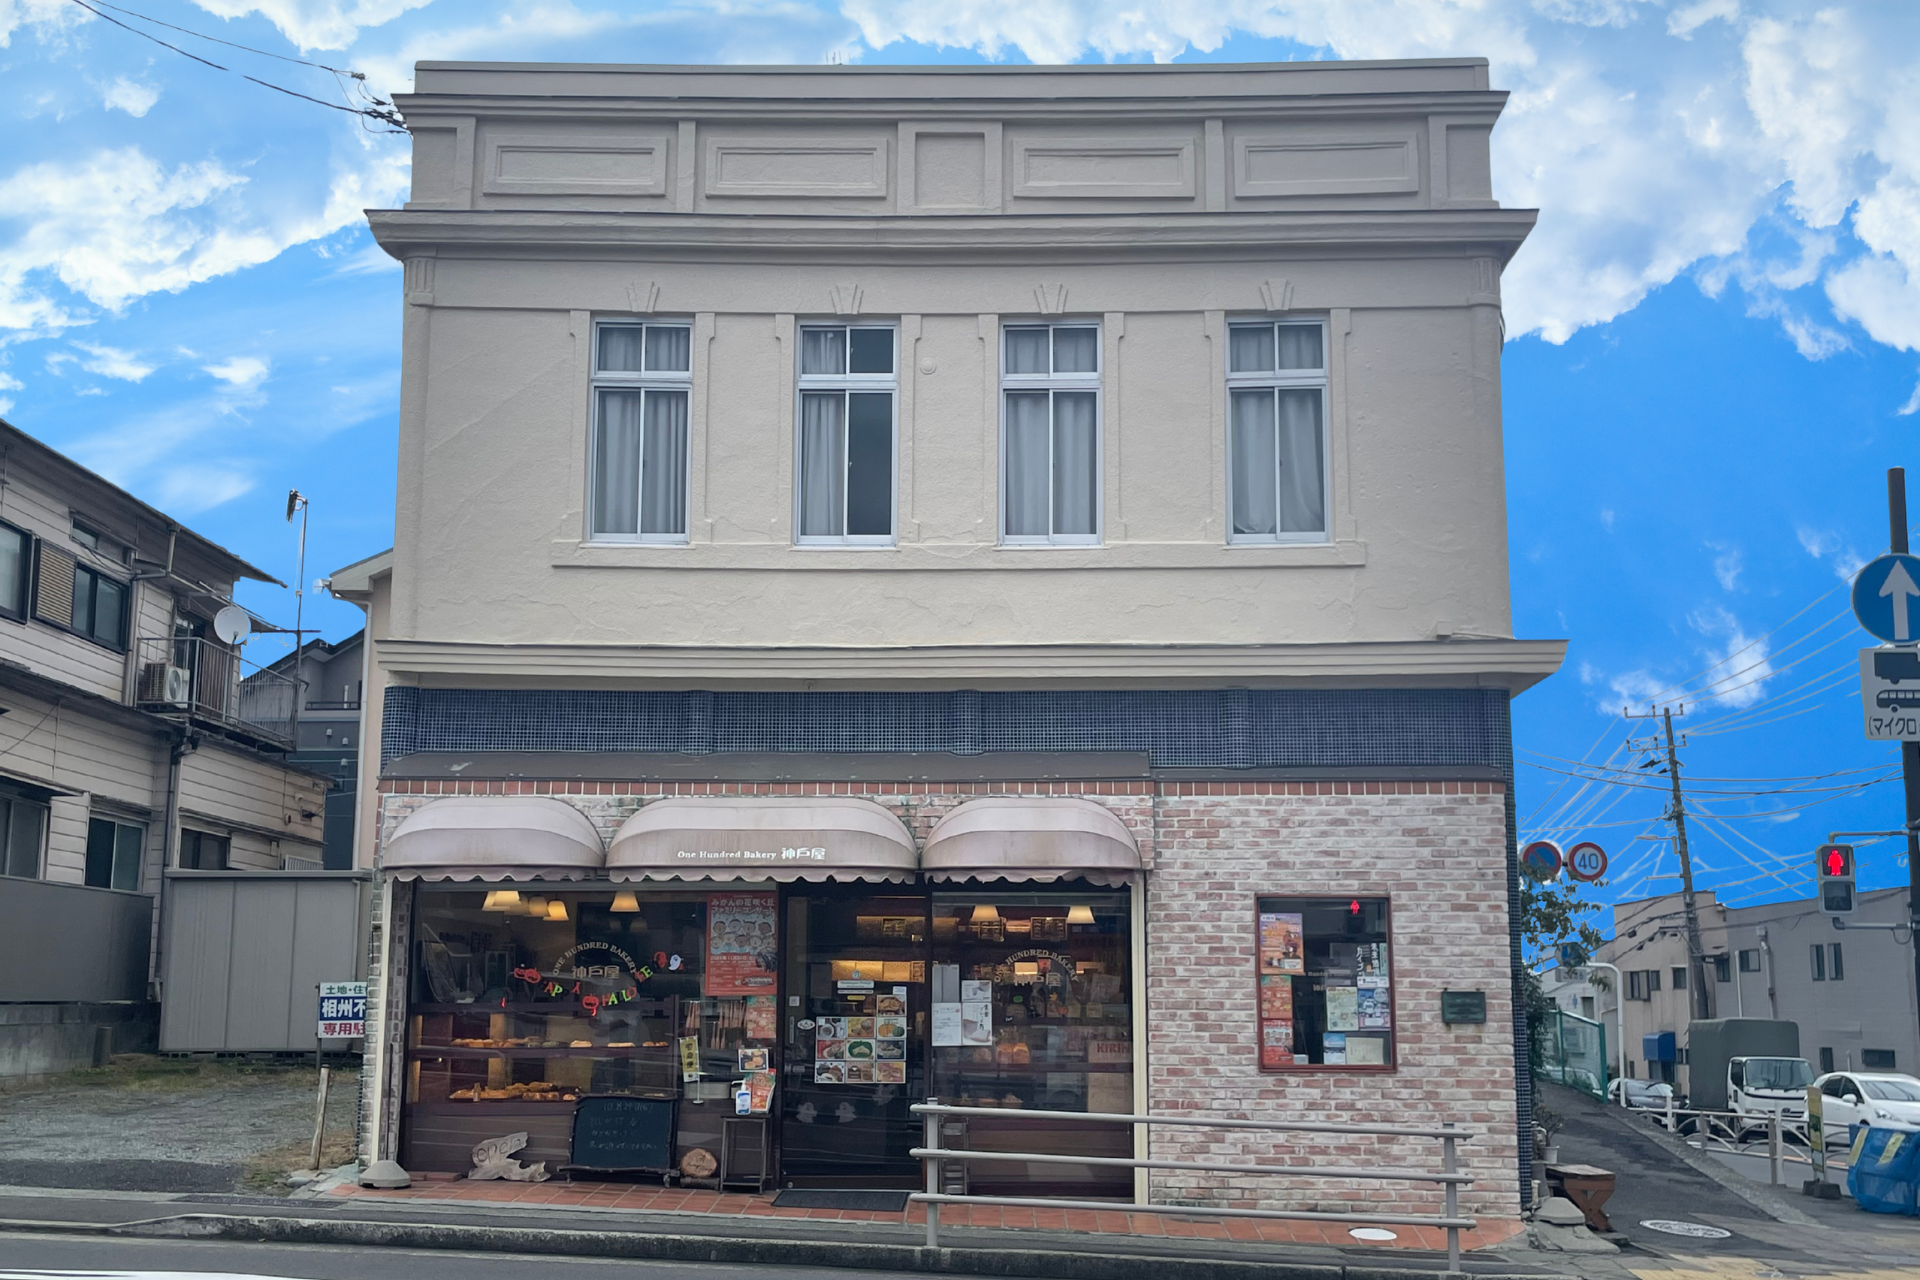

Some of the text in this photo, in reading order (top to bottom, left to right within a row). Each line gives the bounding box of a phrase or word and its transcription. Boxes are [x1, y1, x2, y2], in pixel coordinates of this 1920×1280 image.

[1869, 716, 1920, 736] (マイクロ
[677, 847, 826, 860] One Hundred Bakery 神戸屋
[1578, 852, 1599, 870] 40
[711, 898, 775, 906] みかんの花咲く丘
[711, 906, 774, 914] ファミリーコンサート
[552, 941, 638, 976] ONE HUNDRED BAKERY
[1005, 949, 1049, 965] HUNDRED
[1051, 952, 1080, 983] BAKERY
[572, 965, 620, 979] 神戸屋
[325, 984, 367, 995] 土地・住
[321, 998, 366, 1018] 相州不
[322, 1022, 366, 1036] 専用駐
[477, 1138, 524, 1164] open
